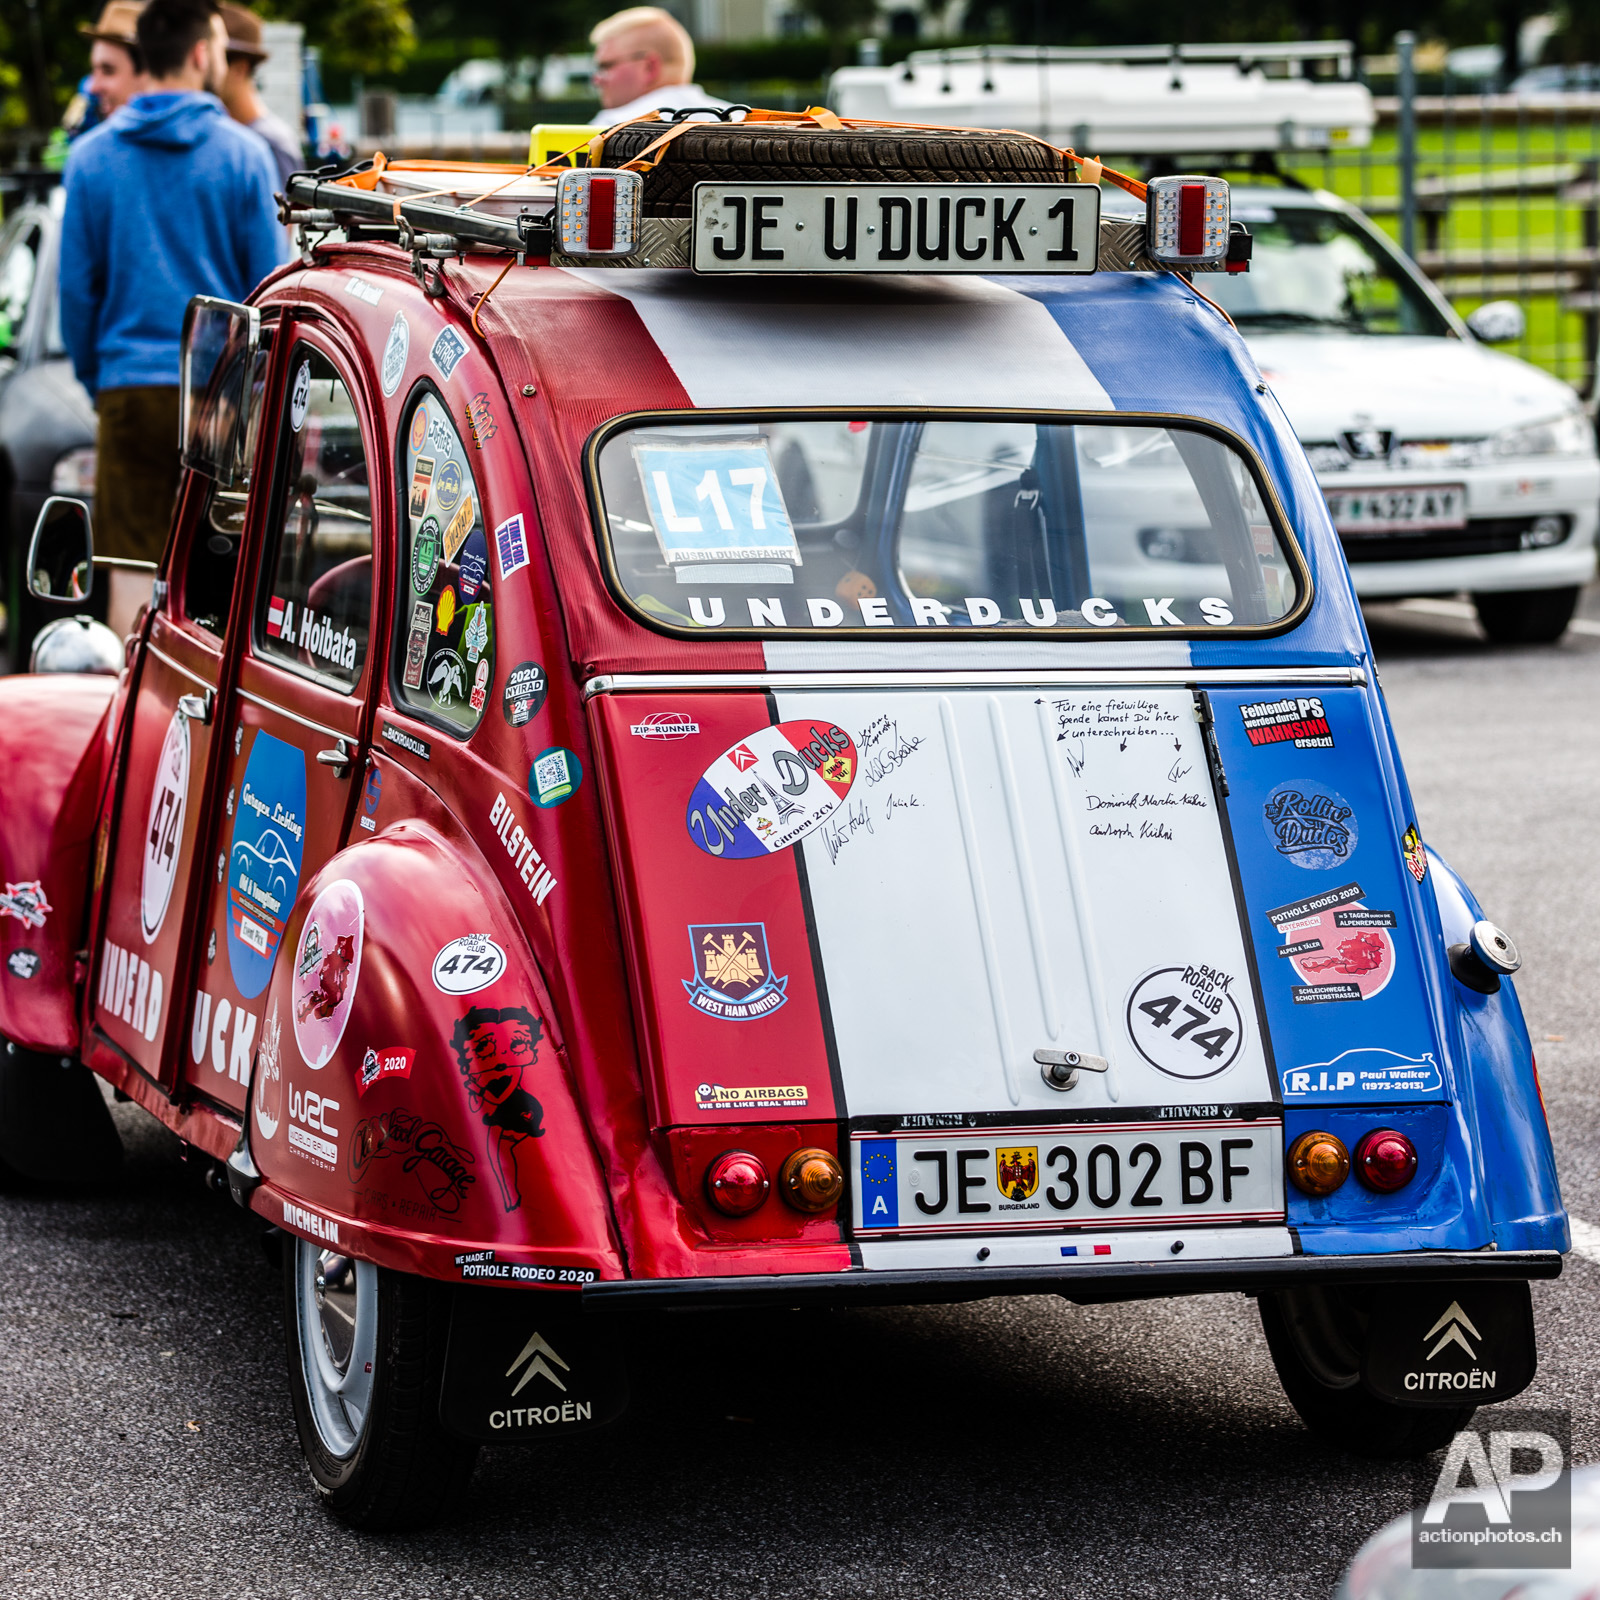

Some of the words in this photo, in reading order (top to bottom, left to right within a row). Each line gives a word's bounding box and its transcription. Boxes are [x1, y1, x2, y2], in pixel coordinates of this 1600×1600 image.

[712, 196, 785, 261] JE
[824, 196, 859, 261] U
[878, 196, 1026, 261] DUCK
[1046, 196, 1079, 261] 1
[650, 467, 772, 534] L17
[508, 518, 522, 546] TIME
[497, 524, 515, 575] TRAVEL
[512, 543, 525, 566] FOR
[673, 547, 794, 563] AUSBILDUNGSFAHRT
[688, 597, 1235, 628] UNDERDUCKS
[280, 601, 296, 644] A.
[299, 607, 357, 670] Hoibata
[511, 667, 539, 685] 2020
[506, 681, 542, 698] NYIRAD
[514, 700, 528, 713] 24
[1052, 699, 1076, 712] Für
[1081, 701, 1102, 712] eine
[1106, 699, 1160, 714] freiwillige
[1240, 699, 1298, 719] Fehlende
[1296, 697, 1325, 719] PS
[1058, 713, 1091, 729] Spende
[1134, 713, 1150, 723] Du
[1155, 711, 1180, 722] hier
[1244, 715, 1276, 728] werden
[1275, 711, 1301, 724] durch
[1246, 717, 1330, 745] WAHNSINN
[1294, 736, 1333, 748] ersetzt!
[690, 782, 768, 857] Under
[772, 725, 851, 796] Ducks
[242, 783, 271, 818] Garagen
[271, 803, 302, 842] Liebling
[150, 786, 182, 872] 474
[773, 819, 812, 849] Citroen
[812, 802, 835, 823] 2CV
[489, 792, 558, 907] BILSTEIN
[1271, 905, 1310, 923] POTHOLE
[1309, 894, 1339, 911] RODEO
[1338, 886, 1360, 900] 2020
[1279, 918, 1320, 932] ÖSTERREICH
[1339, 919, 1392, 927] ALPENREPUBLIK
[458, 937, 479, 947] ROAD
[467, 933, 489, 942] BACK
[1279, 946, 1298, 955] ALPEN
[1303, 940, 1321, 950] TÄLER
[466, 945, 487, 954] CLUB
[439, 954, 497, 975] 474
[1181, 965, 1215, 994] ROAD
[1199, 964, 1235, 993] BACK
[1295, 992, 1360, 1002] SCHOTTERSTRASSEN
[1298, 986, 1347, 995] SCHLEICHWEGE
[696, 994, 724, 1014] WEST
[724, 1004, 748, 1017] HAM
[748, 993, 781, 1015] UNITED
[1191, 989, 1223, 1015] CLUB
[1138, 995, 1235, 1060] 474
[384, 1056, 407, 1071] 2020
[1291, 1072, 1356, 1093] R.I.P
[1359, 1070, 1385, 1081] Paul
[1388, 1069, 1431, 1080] Walker
[1361, 1080, 1424, 1091] (1973-2013)
[720, 1089, 740, 1100] NO
[744, 1087, 805, 1099] AIRBAGS
[783, 1099, 806, 1107] MEN!
[901, 1113, 964, 1127] RENAULT
[1158, 1105, 1219, 1119] RENAULT
[914, 1149, 992, 1215] JE
[1046, 1142, 1164, 1211] 302
[1179, 1138, 1254, 1205] BF
[871, 1195, 889, 1215] A
[998, 1202, 1041, 1211] BURGENLAND
[283, 1201, 339, 1244] MICHELIN
[455, 1256, 465, 1265] WE
[465, 1253, 484, 1263] MADE
[486, 1251, 494, 1261] IT
[463, 1264, 511, 1278] POTHOLE
[512, 1267, 556, 1281] RODEO
[558, 1269, 595, 1283] 2020
[1403, 1368, 1497, 1390] CITROËN
[489, 1400, 593, 1429] CITROËN
